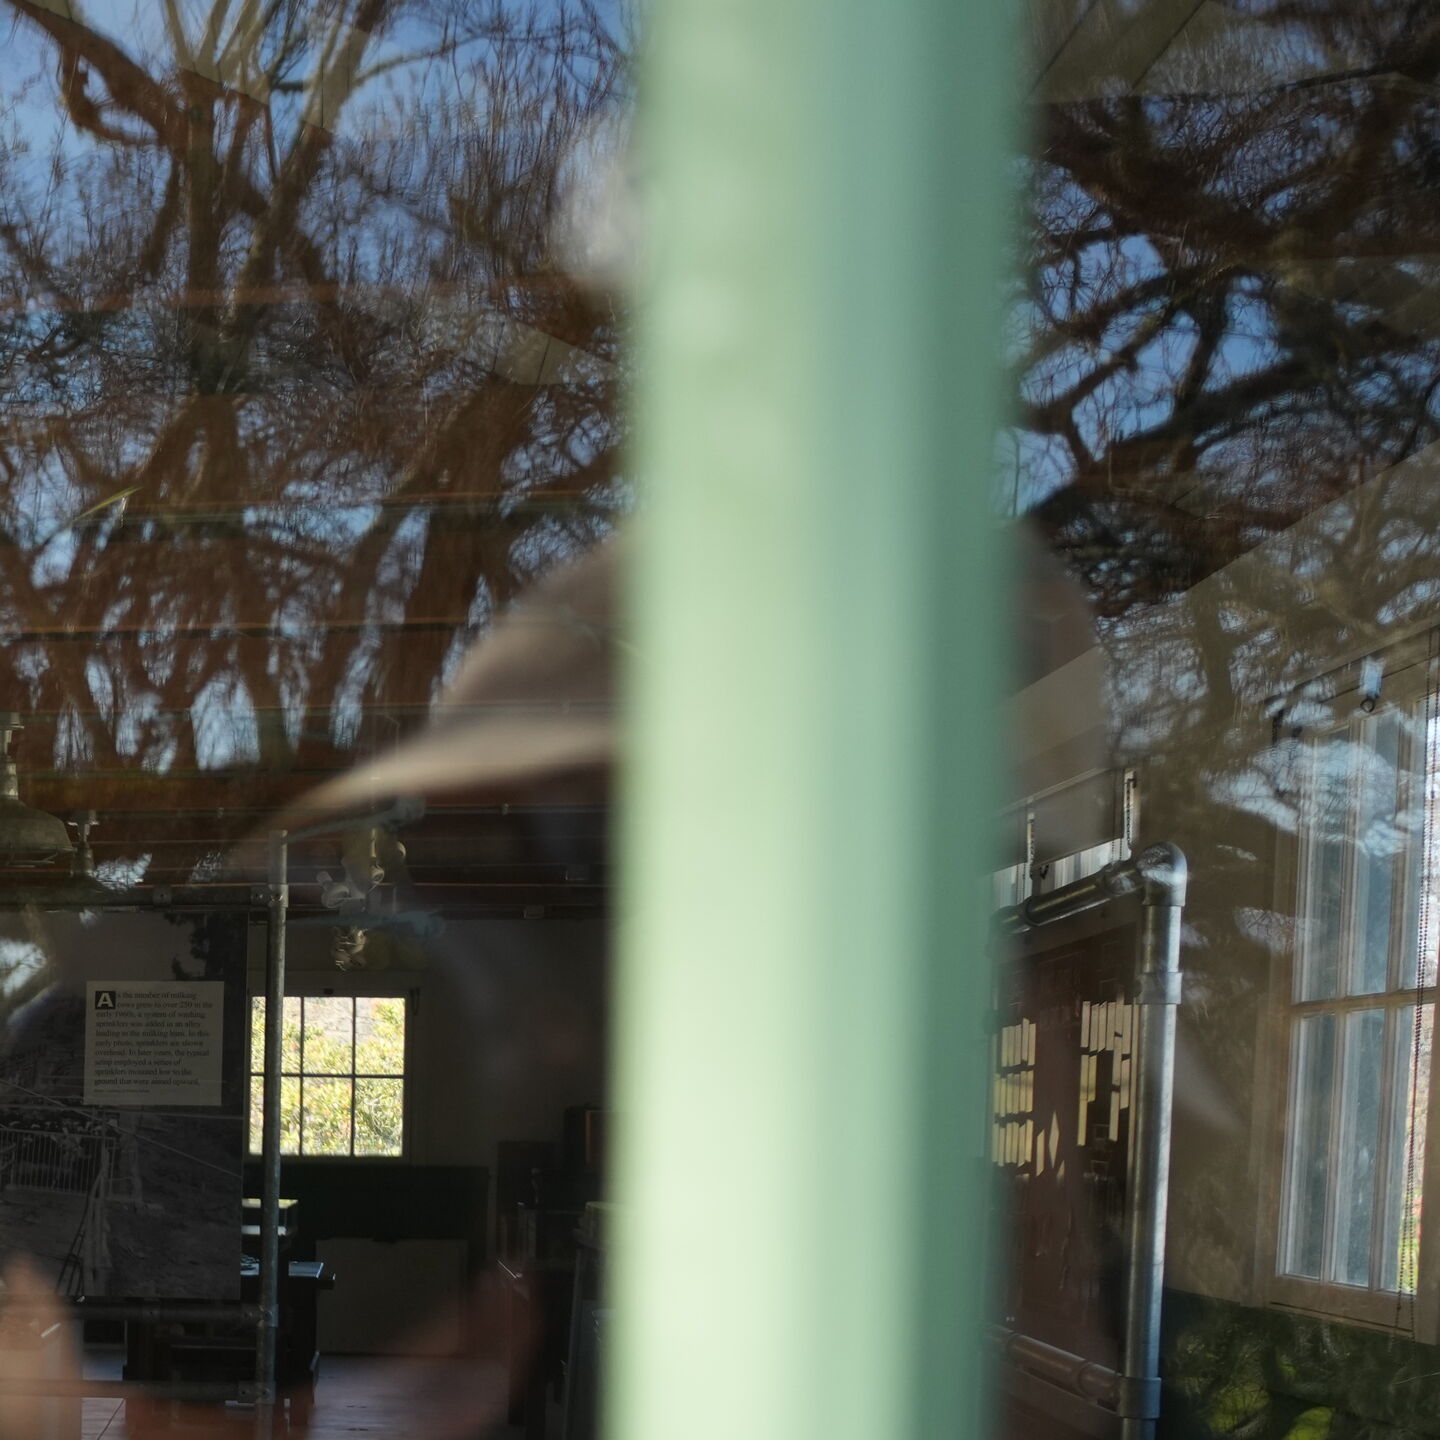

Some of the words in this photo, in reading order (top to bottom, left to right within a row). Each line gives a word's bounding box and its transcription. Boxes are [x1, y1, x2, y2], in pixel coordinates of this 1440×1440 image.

[178, 1011, 206, 1019] washing
[142, 1030, 168, 1038] milking
[187, 1049, 209, 1057] typical
[95, 1068, 127, 1076] sprinklers
